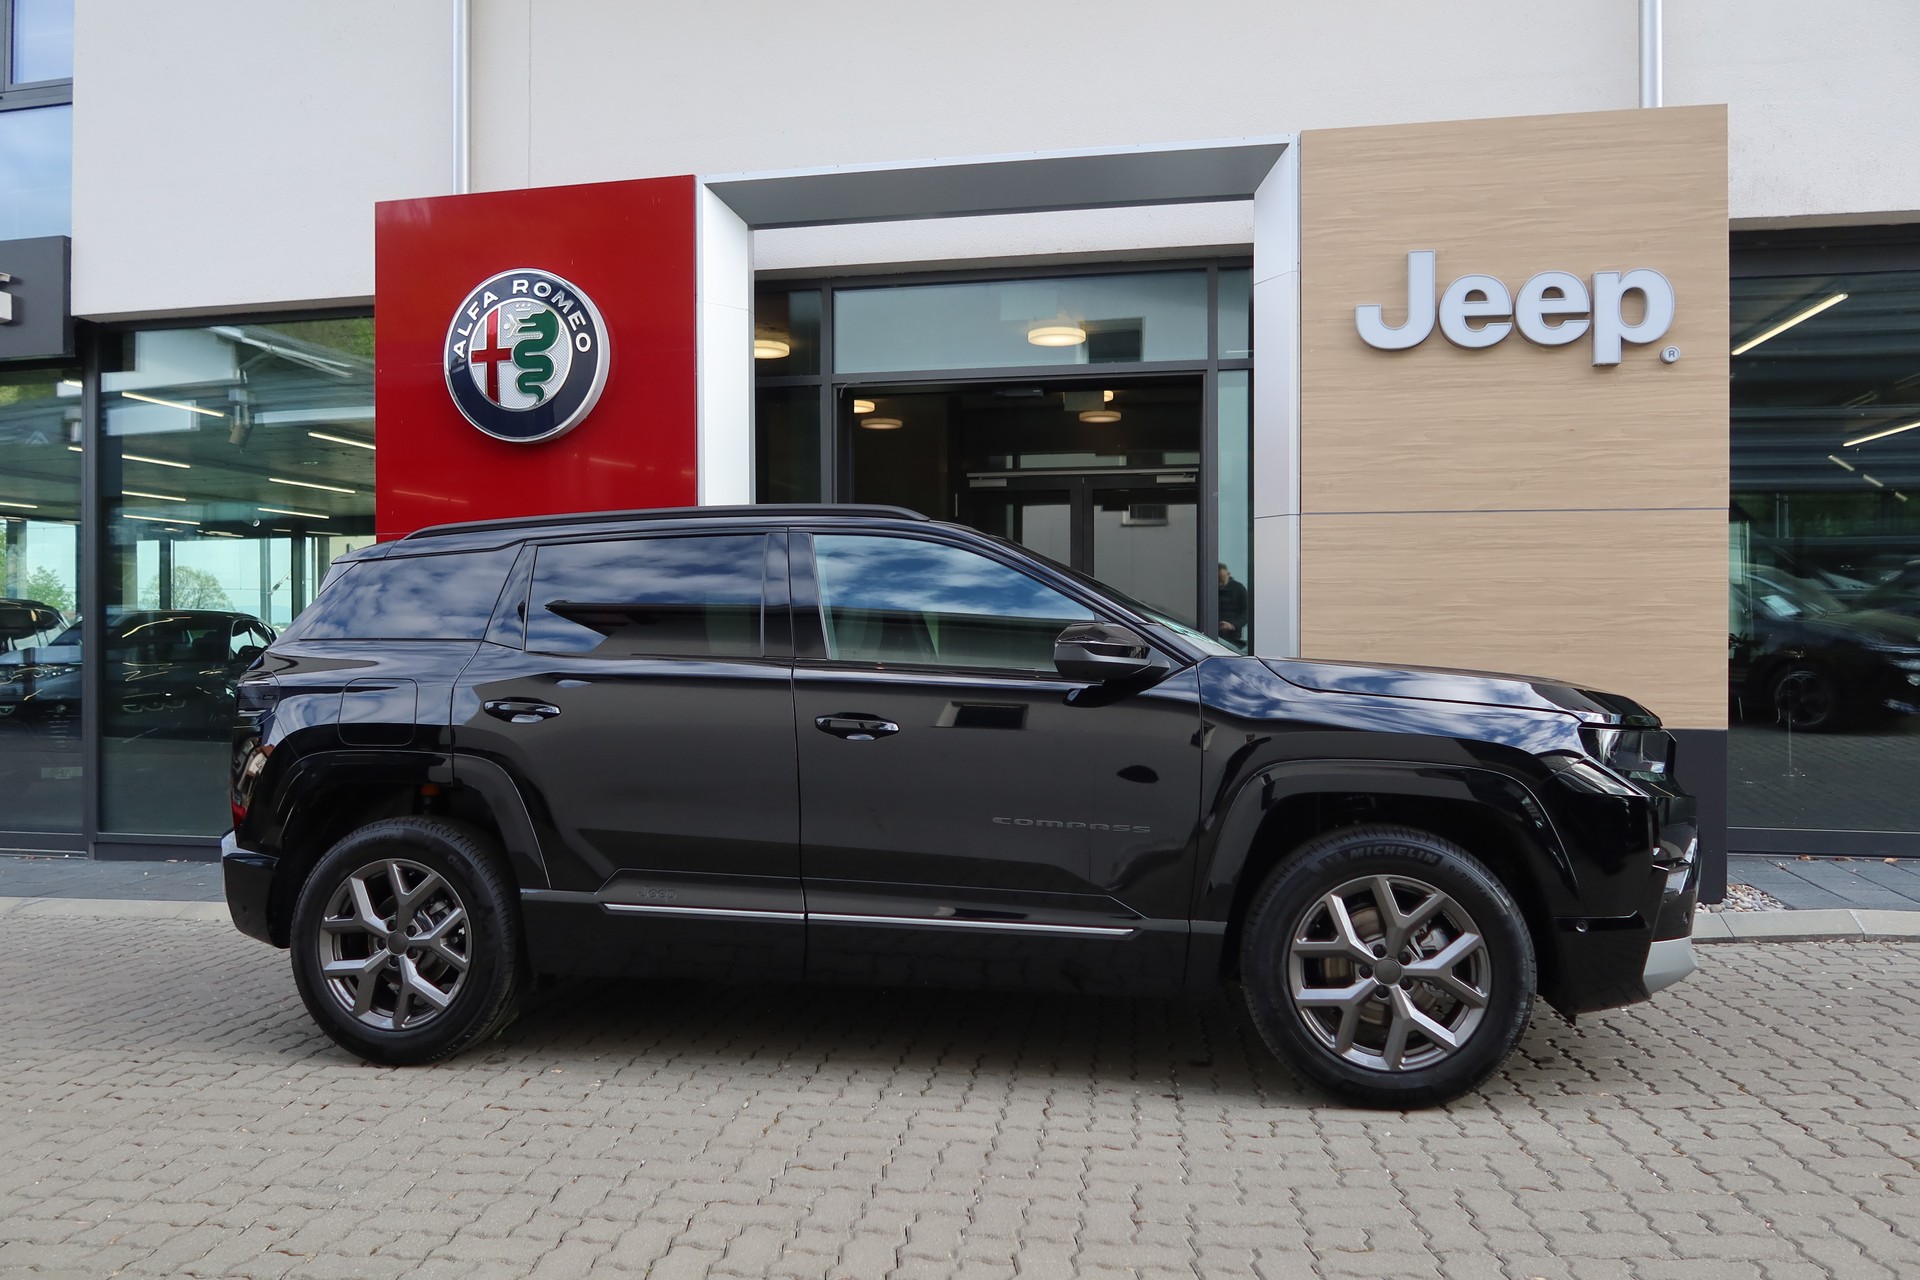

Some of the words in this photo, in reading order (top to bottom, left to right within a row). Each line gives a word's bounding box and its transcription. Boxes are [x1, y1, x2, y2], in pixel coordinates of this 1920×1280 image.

[453, 290, 499, 359] ALFA
[512, 279, 592, 353] ROMEO
[1355, 249, 1675, 367] Jeep
[1349, 845, 1439, 864] MICHELIN
